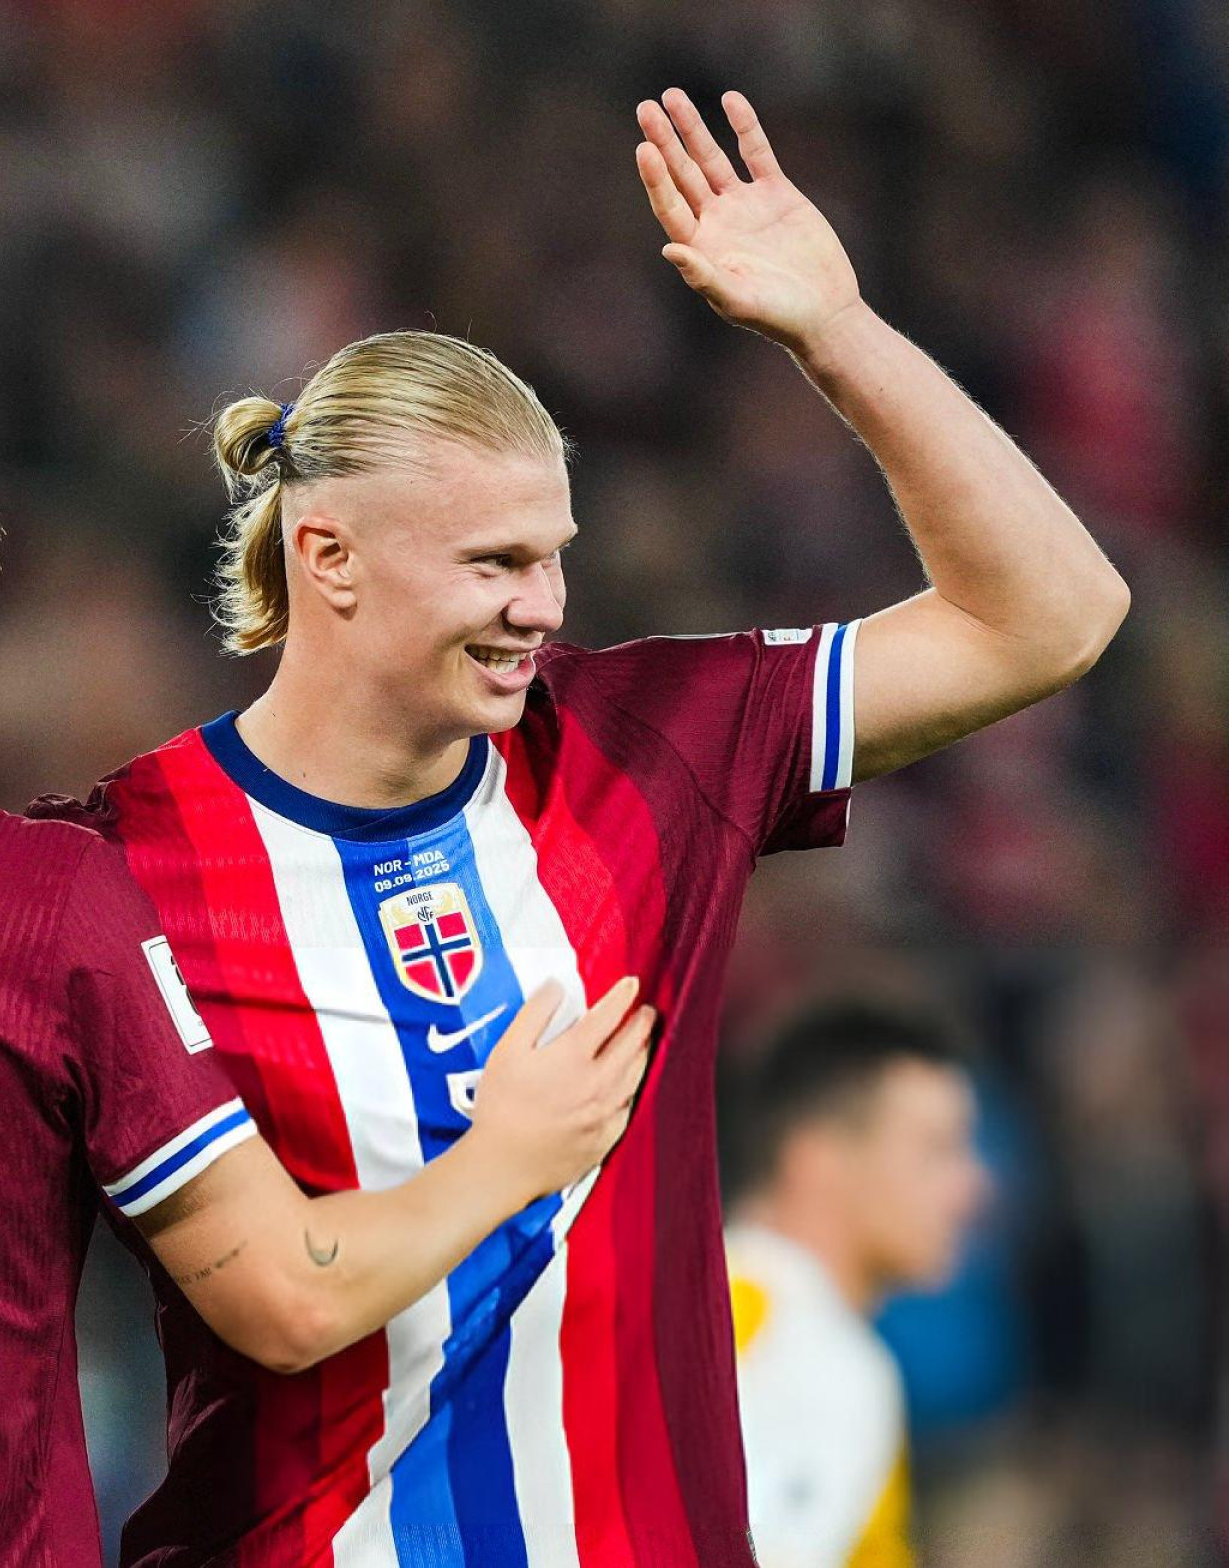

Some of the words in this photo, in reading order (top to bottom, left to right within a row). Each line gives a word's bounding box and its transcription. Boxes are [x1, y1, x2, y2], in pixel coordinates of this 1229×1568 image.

[374, 859, 403, 876] NOR
[413, 850, 445, 867] MDA
[375, 860, 450, 893] 09.09.2025
[406, 891, 434, 906] NORGE
